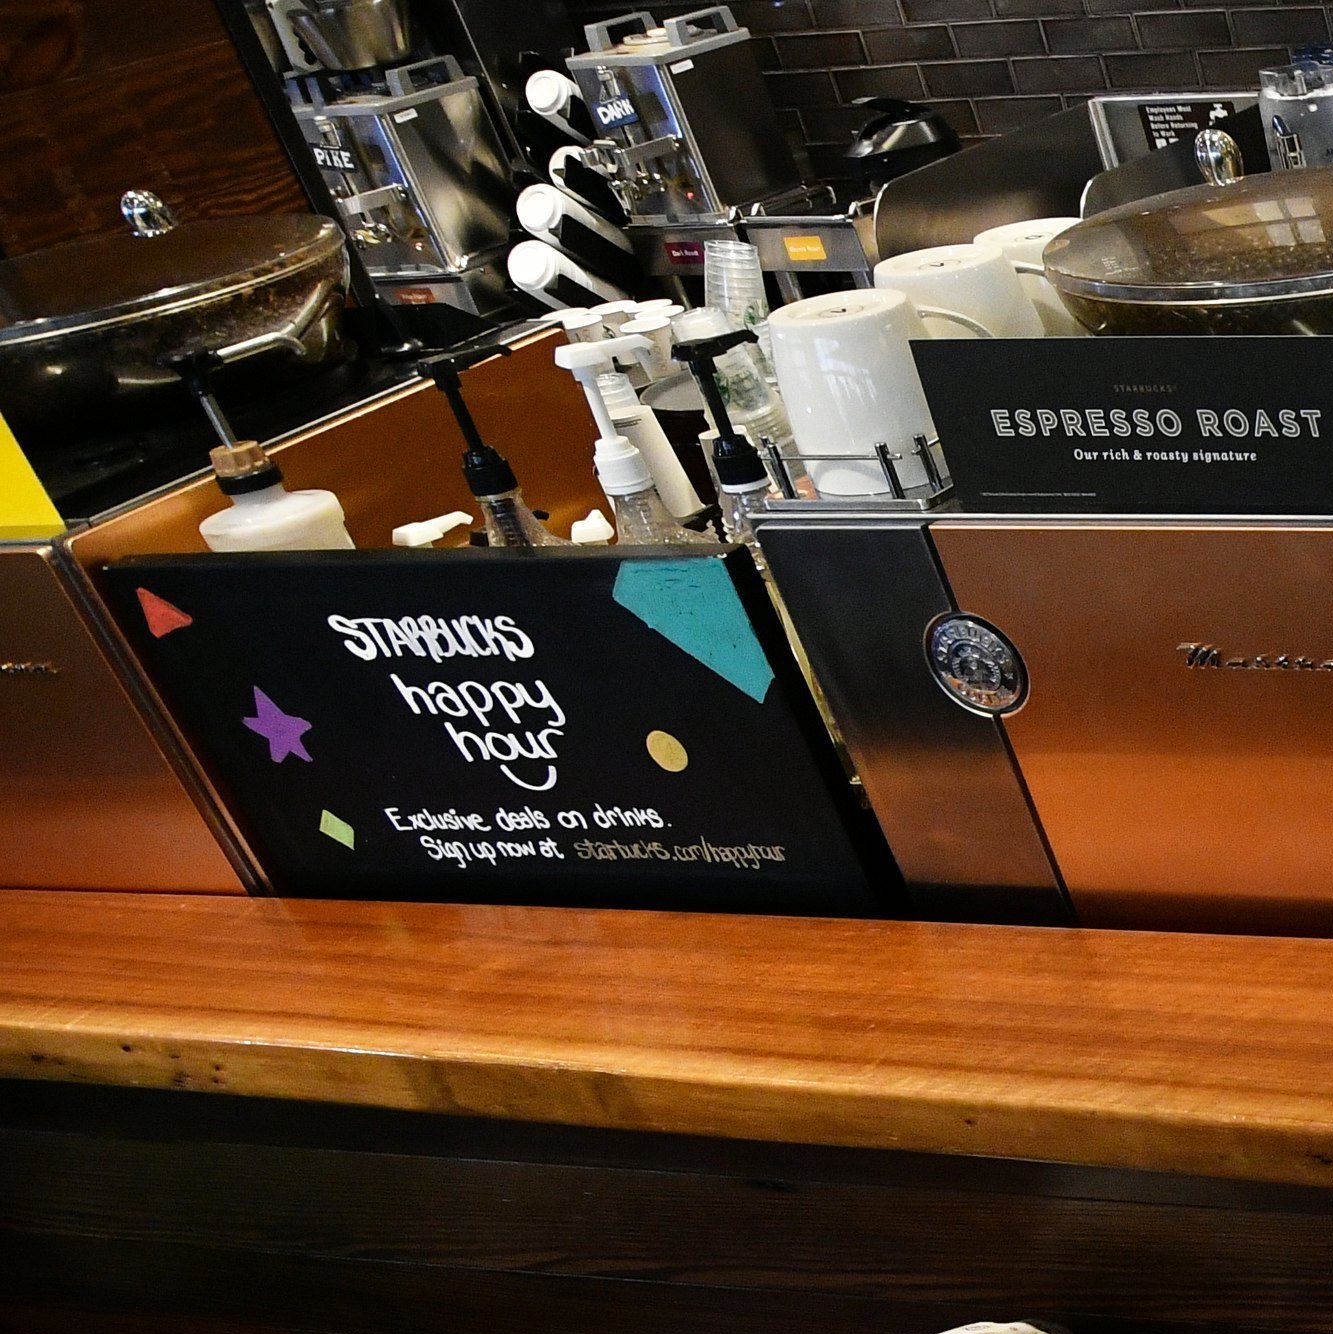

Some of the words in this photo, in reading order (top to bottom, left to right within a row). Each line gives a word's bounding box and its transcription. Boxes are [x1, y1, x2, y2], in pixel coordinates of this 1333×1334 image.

[596, 98, 635, 125] DARK
[1145, 106, 1176, 114] Employees
[1176, 105, 1192, 113] Must
[1148, 114, 1164, 122] Wash
[1150, 122, 1169, 130] Before
[1170, 122, 1199, 130] Returning
[313, 147, 355, 170] PIKE
[990, 409, 1182, 437] ESPRESSO
[1197, 409, 1322, 437] ROAST
[1073, 449, 1099, 461] Our
[1102, 449, 1129, 461] rich
[1133, 449, 1143, 461] &
[1146, 449, 1189, 463] roasty
[1193, 449, 1257, 463] signature
[327, 614, 535, 664] STARBUCKS
[390, 672, 566, 727] happy
[444, 721, 565, 763] hour
[384, 806, 492, 832] Exclusive
[495, 805, 551, 832] deals
[557, 809, 588, 830] on
[592, 802, 673, 829] drinks.
[419, 835, 473, 869] Sign
[468, 841, 497, 866] up
[496, 840, 537, 858] now
[538, 836, 565, 860] at
